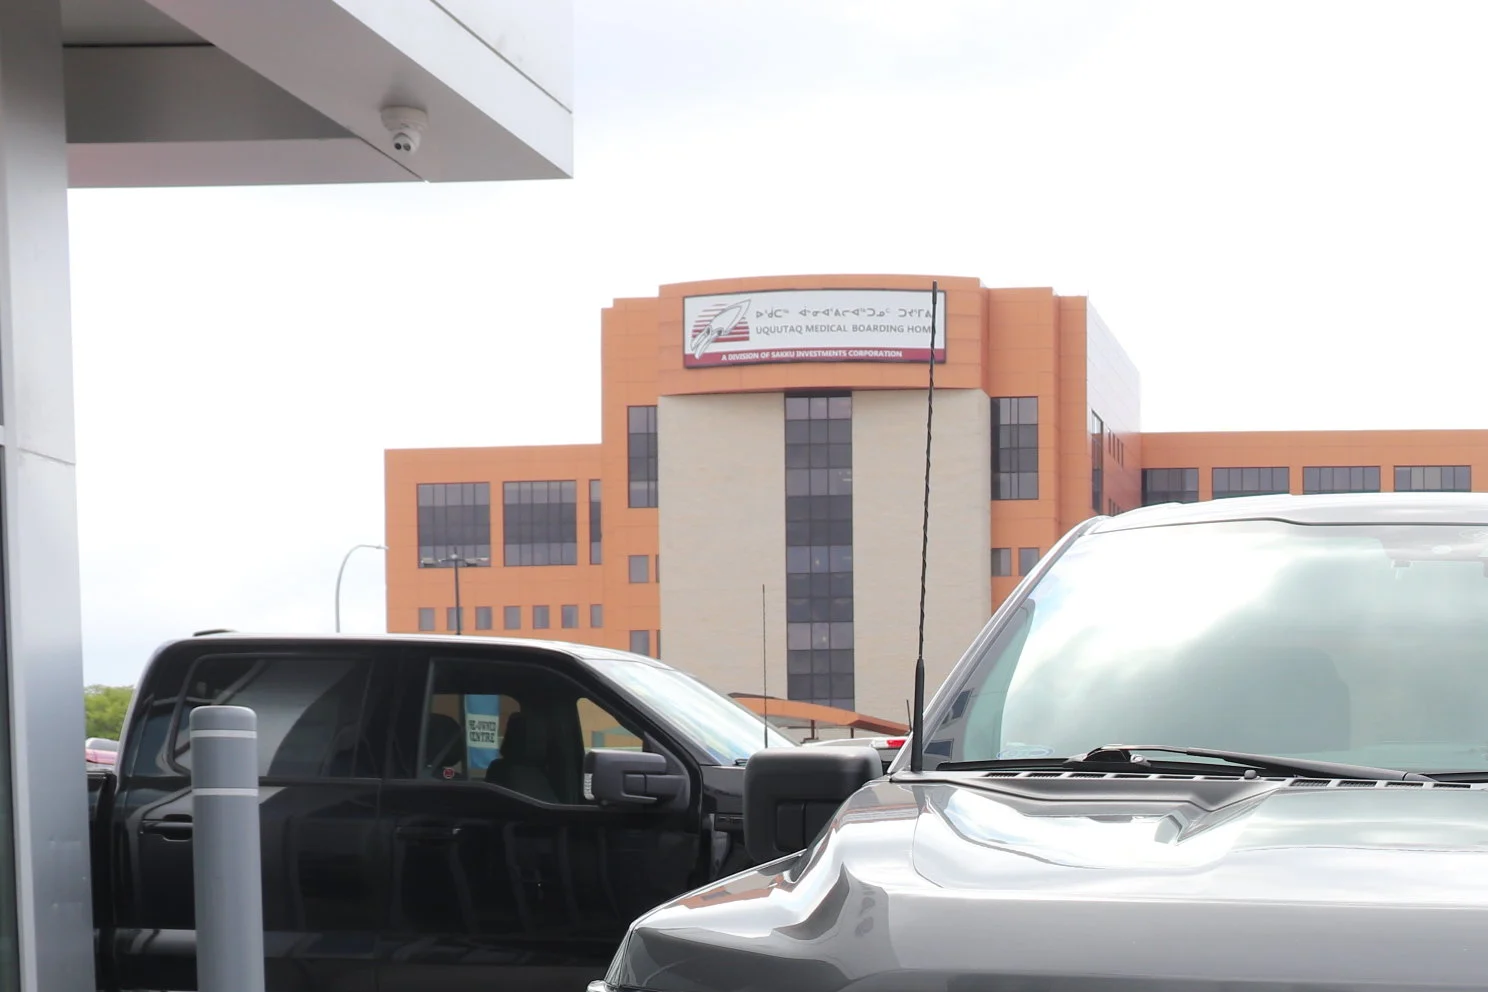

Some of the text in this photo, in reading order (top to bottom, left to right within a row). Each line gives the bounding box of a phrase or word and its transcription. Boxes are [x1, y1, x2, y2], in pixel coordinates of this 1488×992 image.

[755, 323, 936, 336] UQUUTAQ MEDICAL BOARDING HOM
[728, 352, 759, 361] DIVISION
[760, 351, 771, 360] OF
[796, 349, 848, 359] INVESTMENTS
[848, 349, 903, 358] CORPORATION
